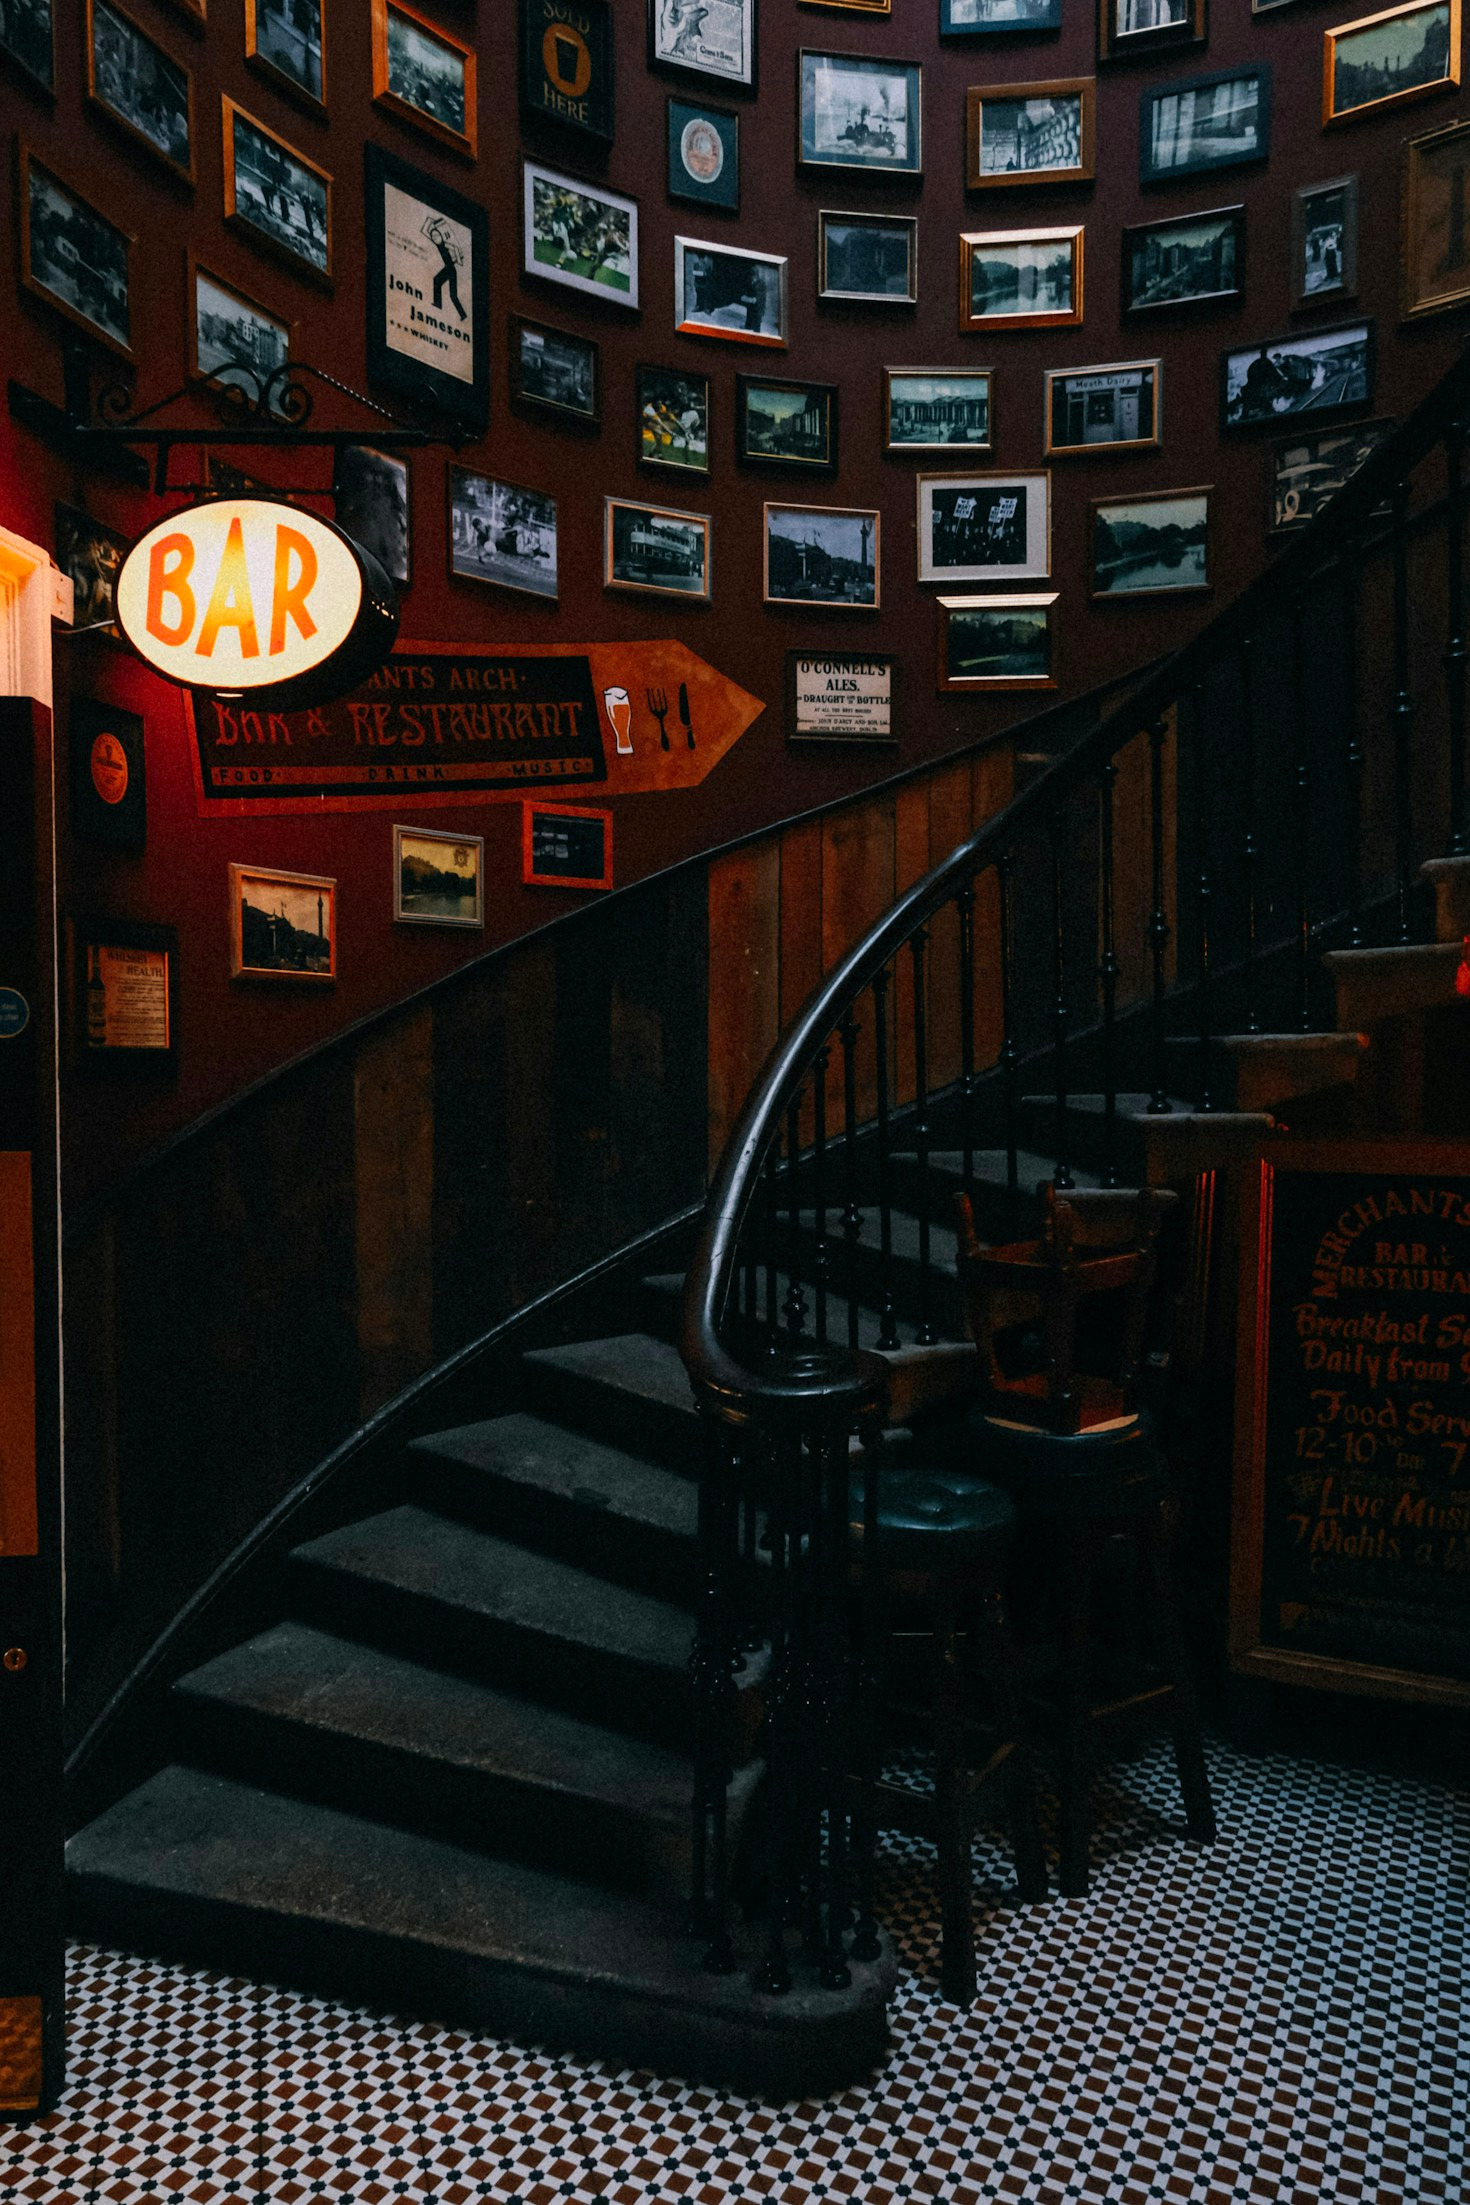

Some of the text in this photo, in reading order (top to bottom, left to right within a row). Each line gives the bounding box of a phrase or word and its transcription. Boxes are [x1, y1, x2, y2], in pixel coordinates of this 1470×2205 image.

[544, 80, 589, 124] HERE
[389, 274, 423, 301] John
[410, 305, 471, 343] Jameson
[410, 328, 449, 350] WHISKEY
[1076, 378, 1103, 388] Meath
[145, 517, 319, 659] BAR
[801, 661, 886, 677] O'CONNELL'S
[825, 679, 860, 692] ALES.
[803, 694, 846, 704] DRAUGHT
[210, 700, 294, 747] BAR
[347, 701, 584, 746] RESTAURANT
[219, 760, 583, 783] FOOD DRINK MUSIC
[1311, 1187, 1470, 1300] MERCHANTS
[1375, 1241, 1428, 1265] BAR
[1340, 1265, 1470, 1295] RESTAURA
[1291, 1302, 1430, 1345] Breakfast
[1299, 1338, 1382, 1389] Daily
[1386, 1346, 1450, 1383] from
[1309, 1388, 1470, 1437] Food Serv
[1439, 1440, 1468, 1477] 7
[1318, 1475, 1385, 1520] Live
[1392, 1491, 1470, 1530] Musi
[1286, 1513, 1311, 1547] 7
[1309, 1518, 1402, 1560] Nights
